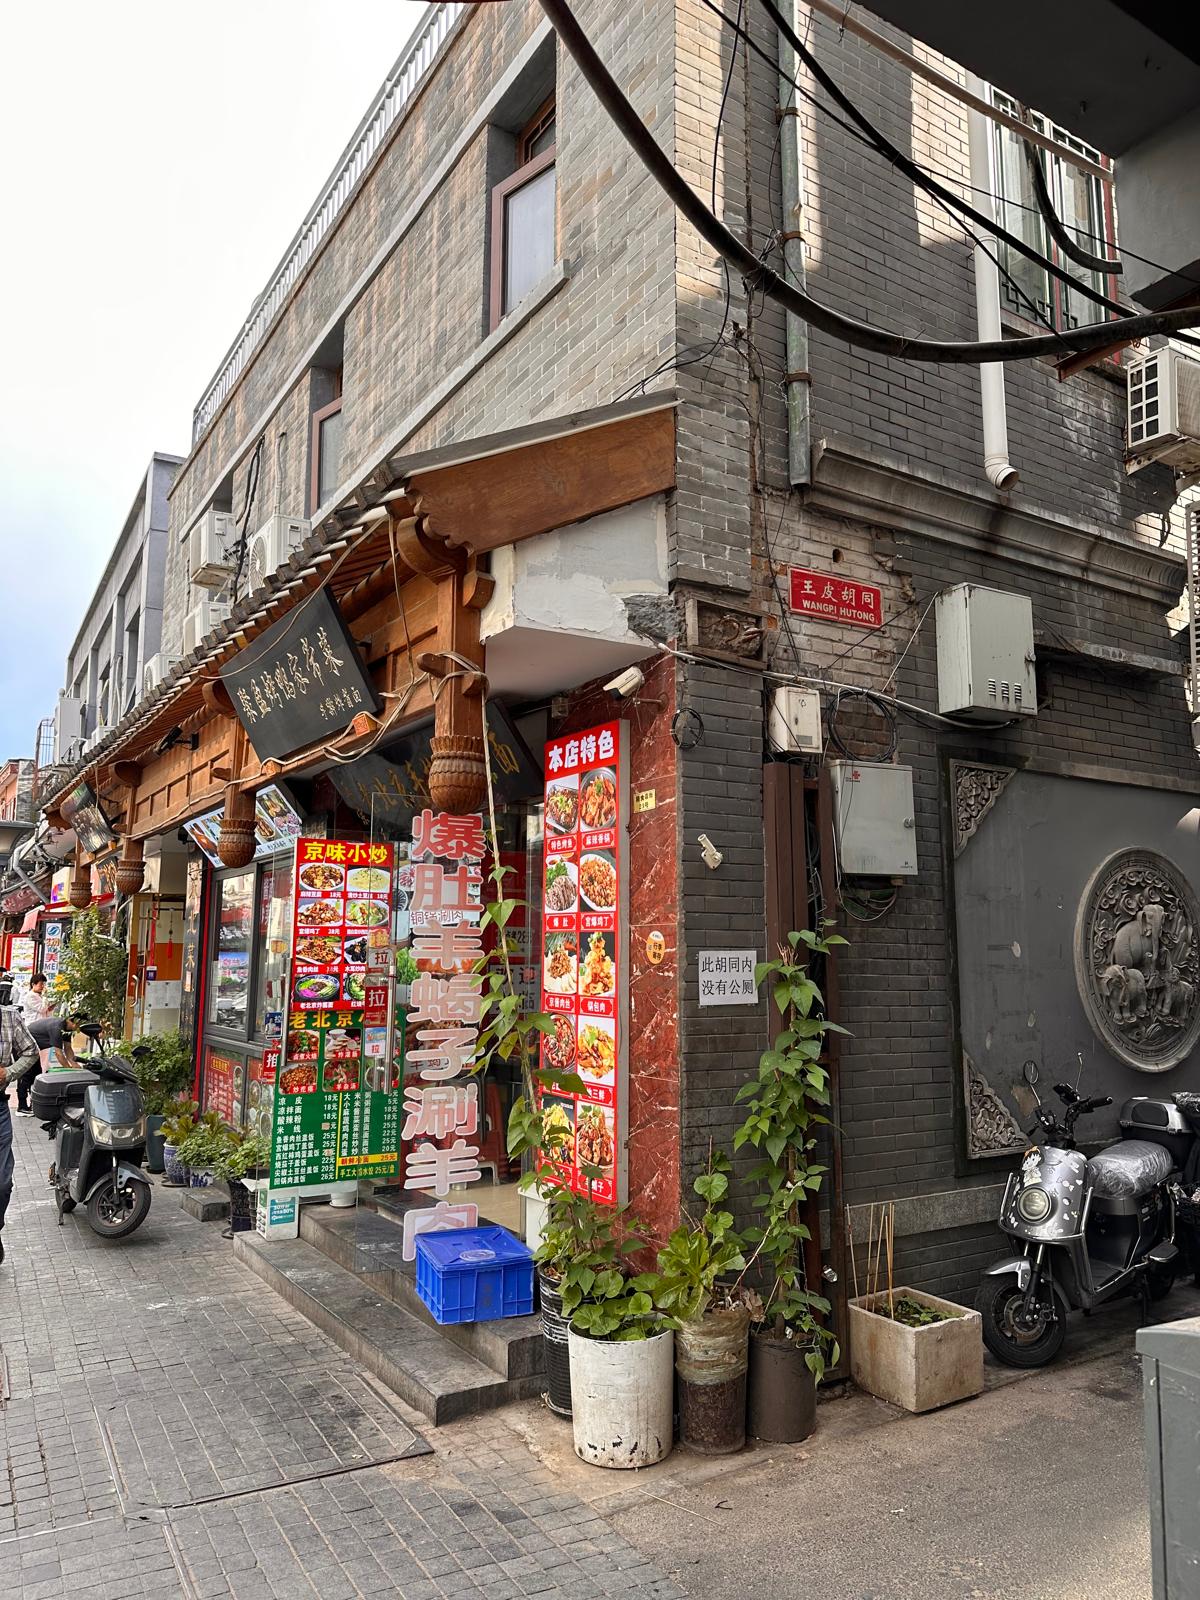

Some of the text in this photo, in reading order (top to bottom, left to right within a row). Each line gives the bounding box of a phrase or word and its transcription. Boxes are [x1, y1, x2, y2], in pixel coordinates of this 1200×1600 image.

[801, 580, 874, 609] 王皮胡同
[802, 599, 875, 622] WANGPI HUTONG
[548, 729, 615, 773] 本店特色
[303, 841, 388, 864] 京味小炒
[702, 956, 752, 973] 此胡同内
[368, 989, 386, 1008] 拉
[702, 979, 753, 996] 没有公厕
